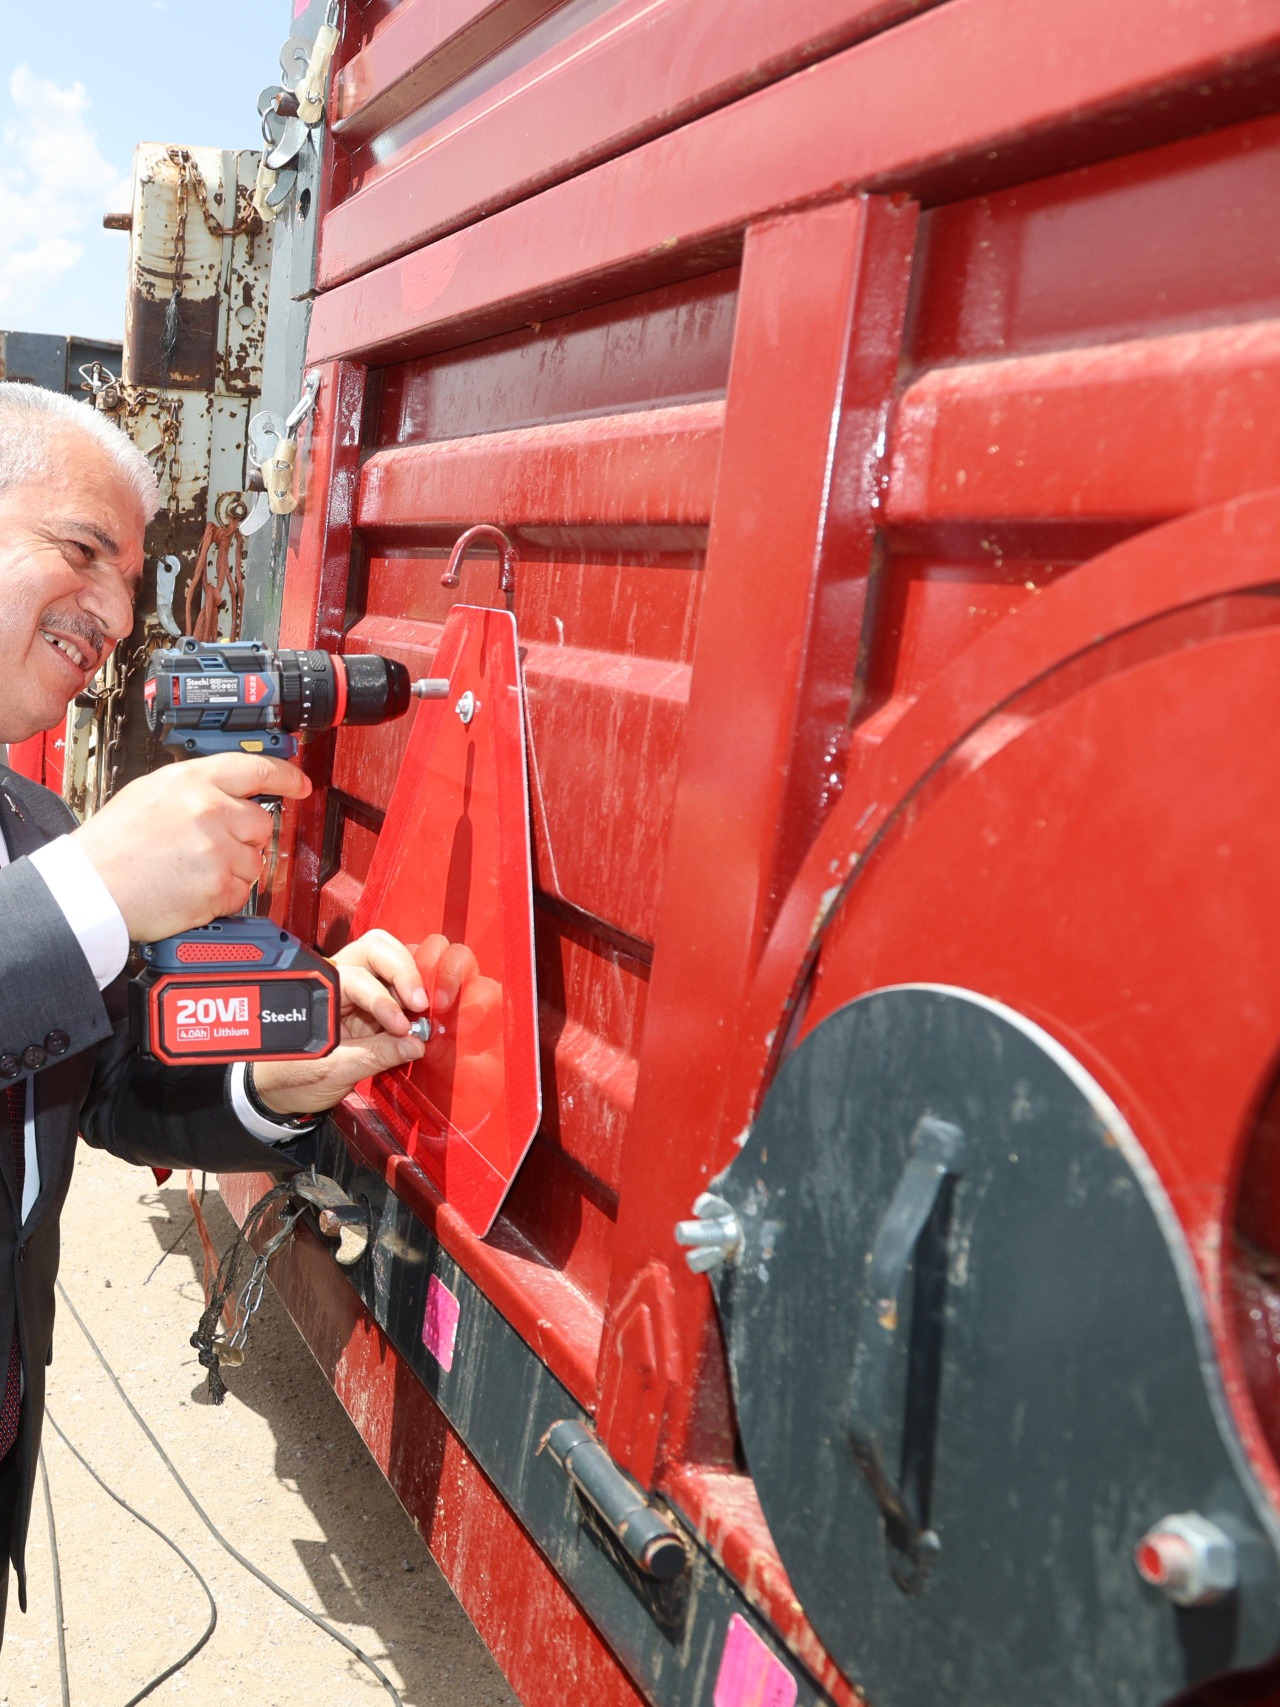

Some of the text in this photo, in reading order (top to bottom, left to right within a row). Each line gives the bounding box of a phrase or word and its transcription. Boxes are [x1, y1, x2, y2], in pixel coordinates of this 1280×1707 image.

[249, 675, 257, 702] SX22
[176, 997, 238, 1025] 20V
[179, 1027, 249, 1039] 4.0Ah Lithium
